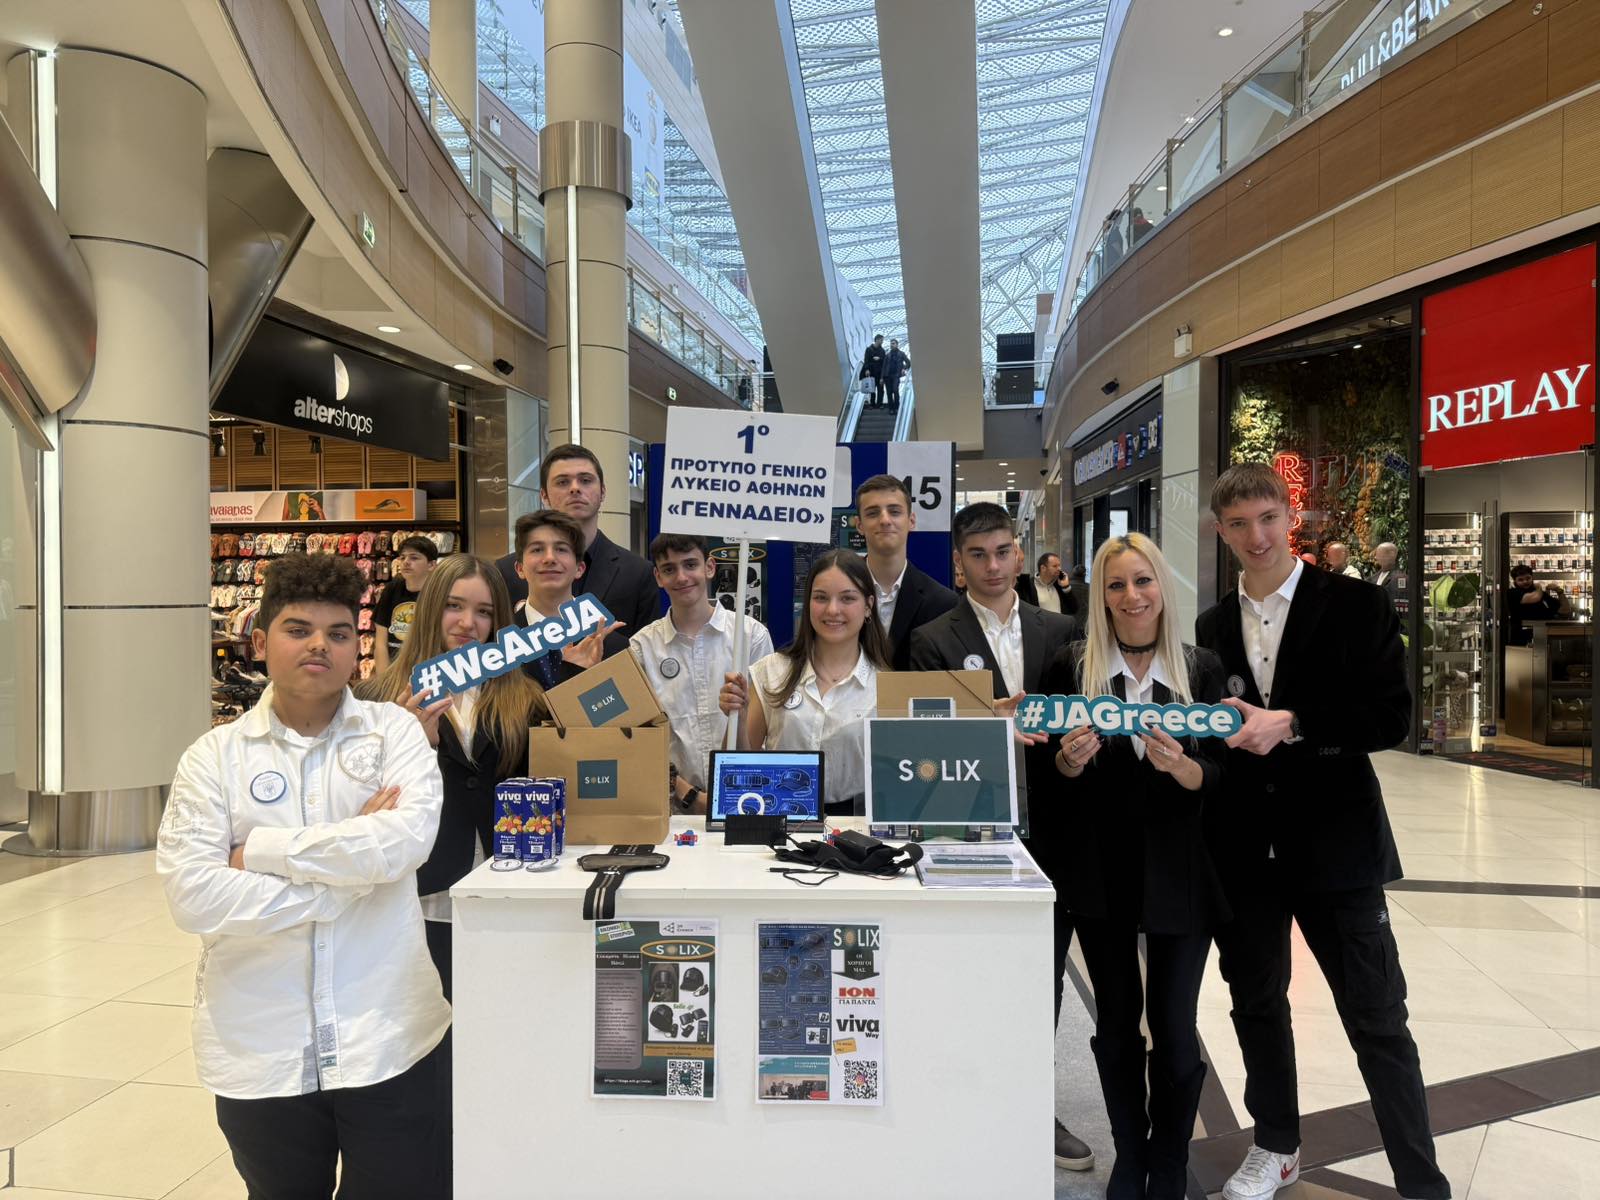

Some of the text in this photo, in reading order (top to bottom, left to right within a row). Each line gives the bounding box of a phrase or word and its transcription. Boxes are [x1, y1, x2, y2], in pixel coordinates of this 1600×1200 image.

[1427, 363, 1592, 433] REPLAY
[294, 396, 373, 436] altershops
[670, 457, 827, 479] ΠΡΟΤΥΠΟ ΓΕΝΙΚΟ
[670, 476, 826, 498] ΛΥΚΕΙΟ ΑΘΗΝΩΝ
[667, 501, 825, 524] «ΓΕΝΝΑΔΕΙΟ»
[418, 599, 608, 700] #WeAreJA
[1021, 701, 1233, 732] #JAGreece
[497, 791, 521, 801] viva
[525, 791, 549, 801] viva
[836, 1014, 880, 1032] viva
